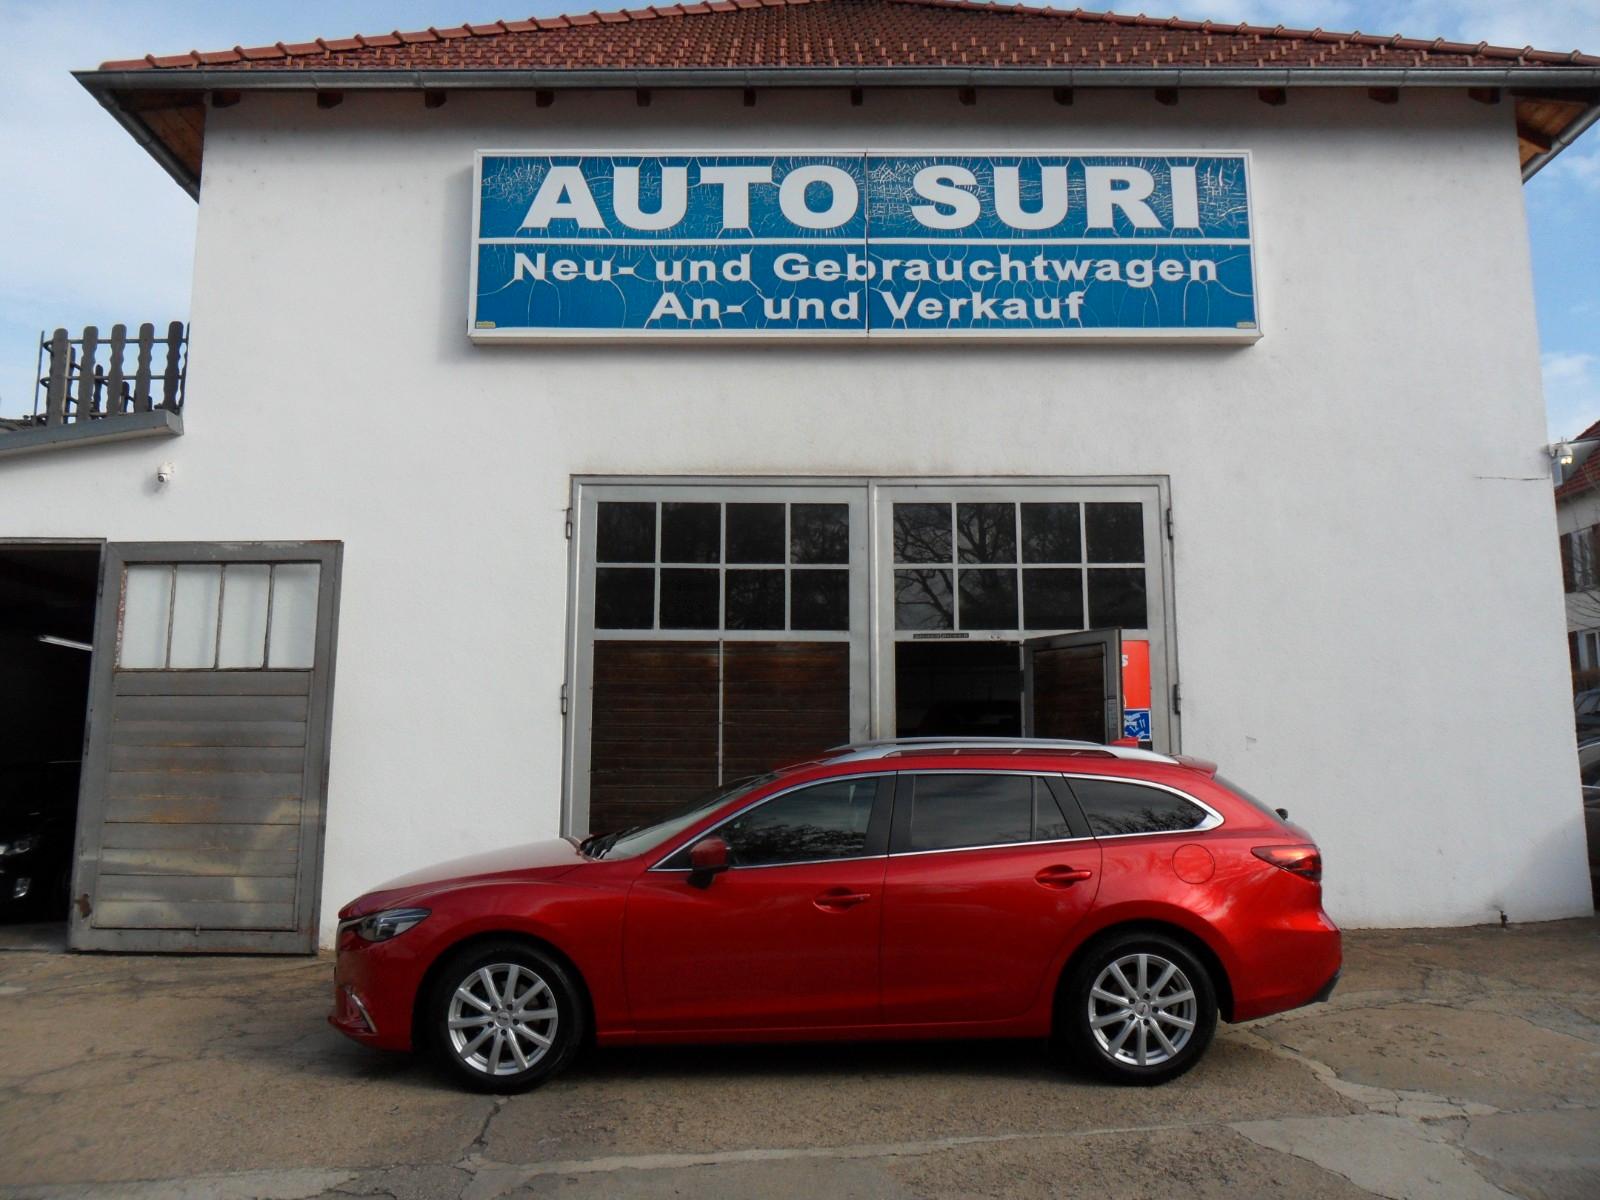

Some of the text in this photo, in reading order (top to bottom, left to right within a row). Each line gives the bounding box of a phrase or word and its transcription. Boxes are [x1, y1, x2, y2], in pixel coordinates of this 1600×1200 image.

[521, 164, 1197, 231] AUTO SURI
[513, 252, 1217, 288] Neu- und Gebrauchtwagen
[650, 290, 1085, 321] An- und Verkauf
